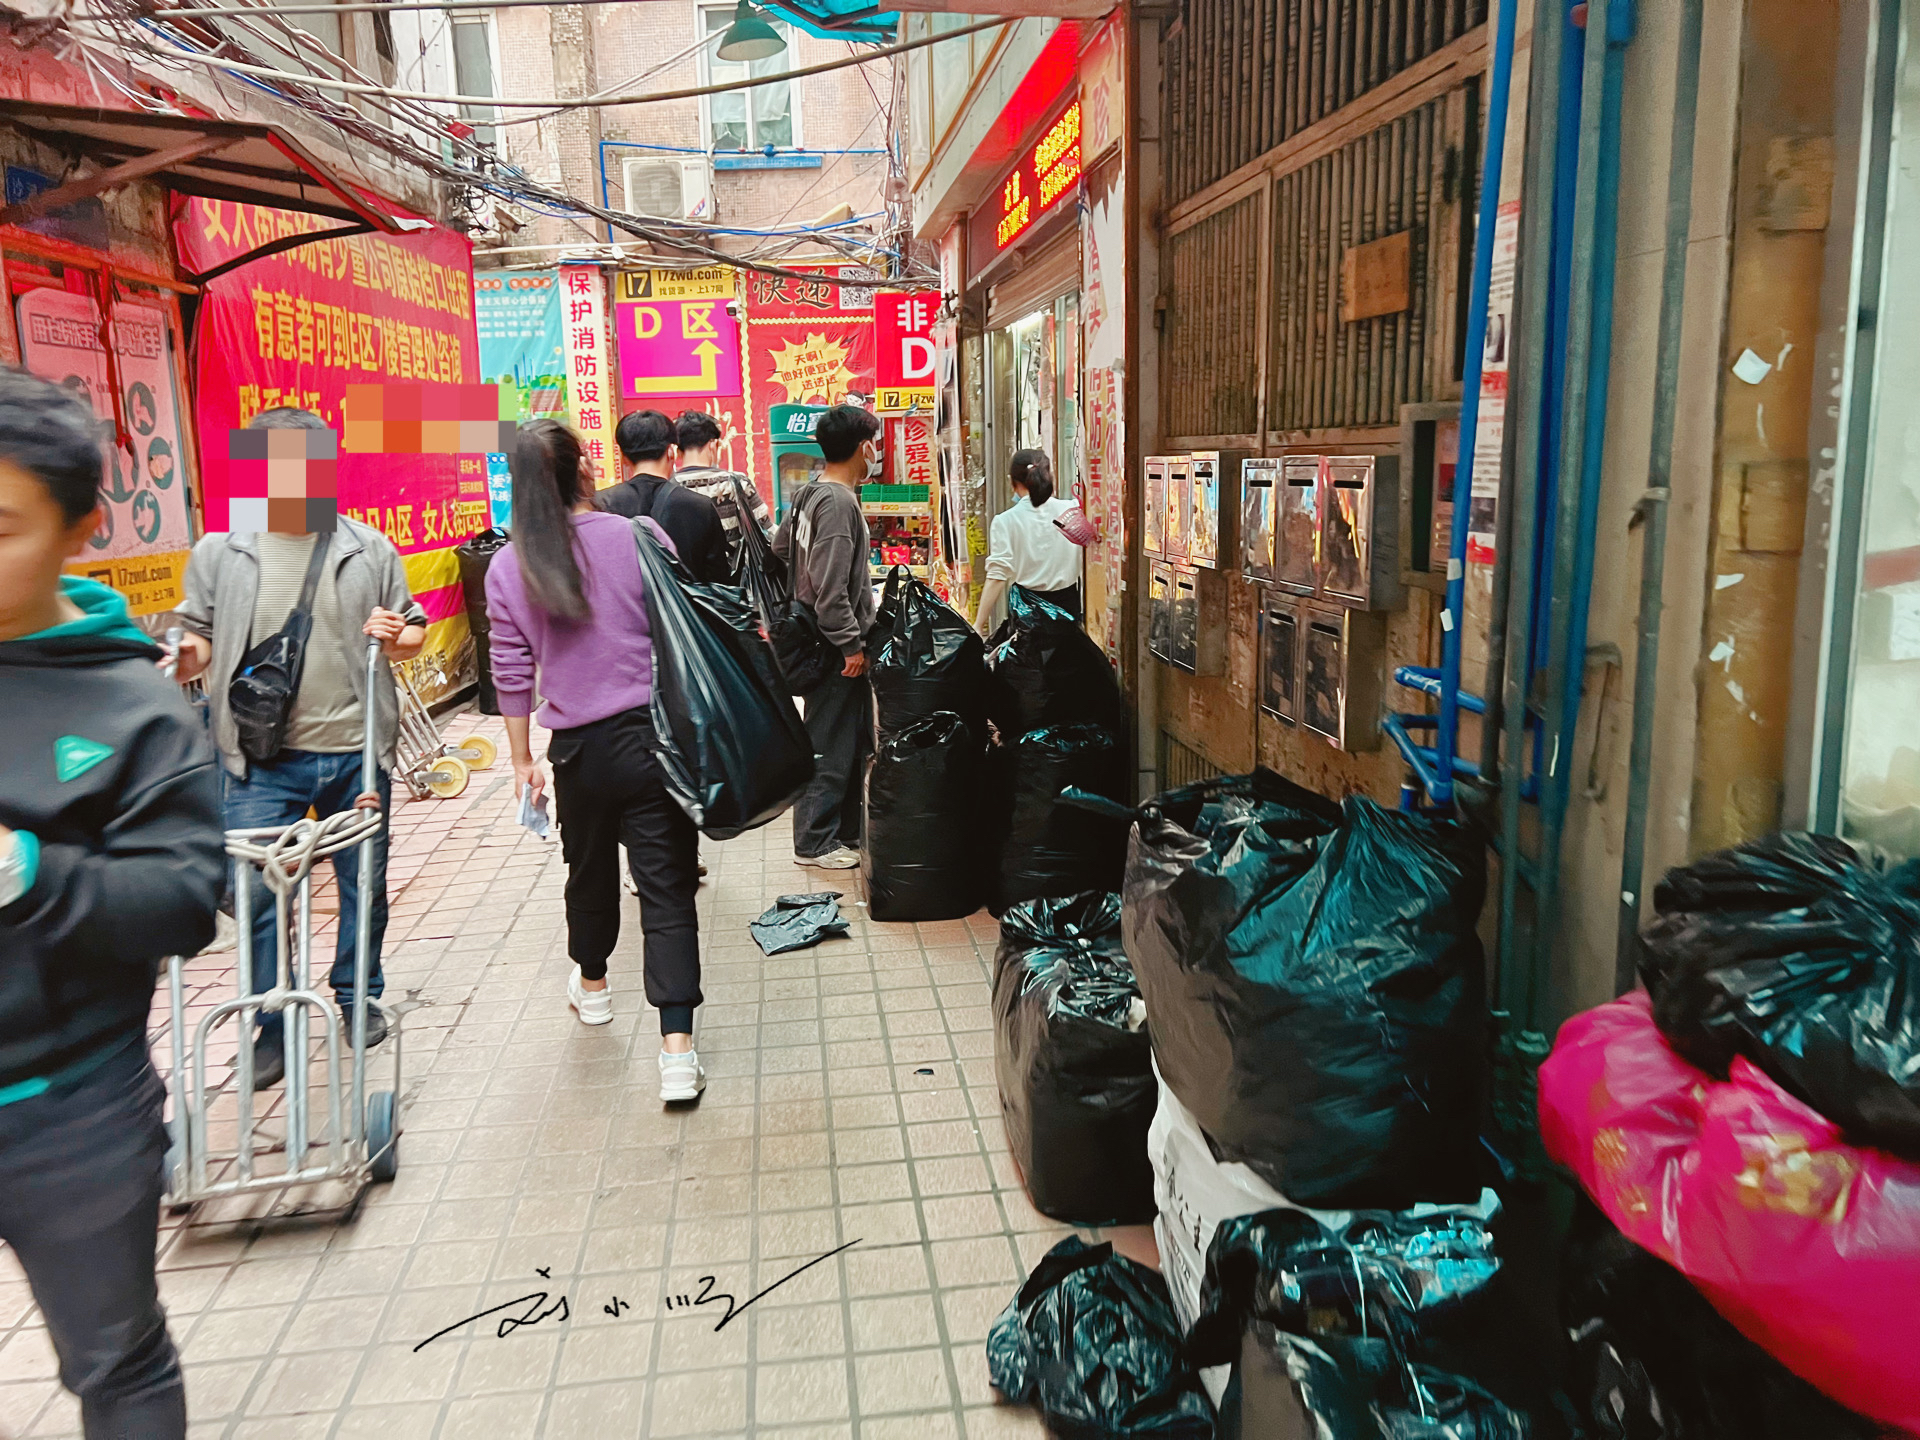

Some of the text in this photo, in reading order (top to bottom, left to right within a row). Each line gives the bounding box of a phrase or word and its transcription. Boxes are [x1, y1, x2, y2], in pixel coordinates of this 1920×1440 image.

[657, 267, 723, 282] 17zwd.com
[634, 302, 718, 339] D 区
[897, 300, 928, 332] 非
[902, 337, 935, 379] D
